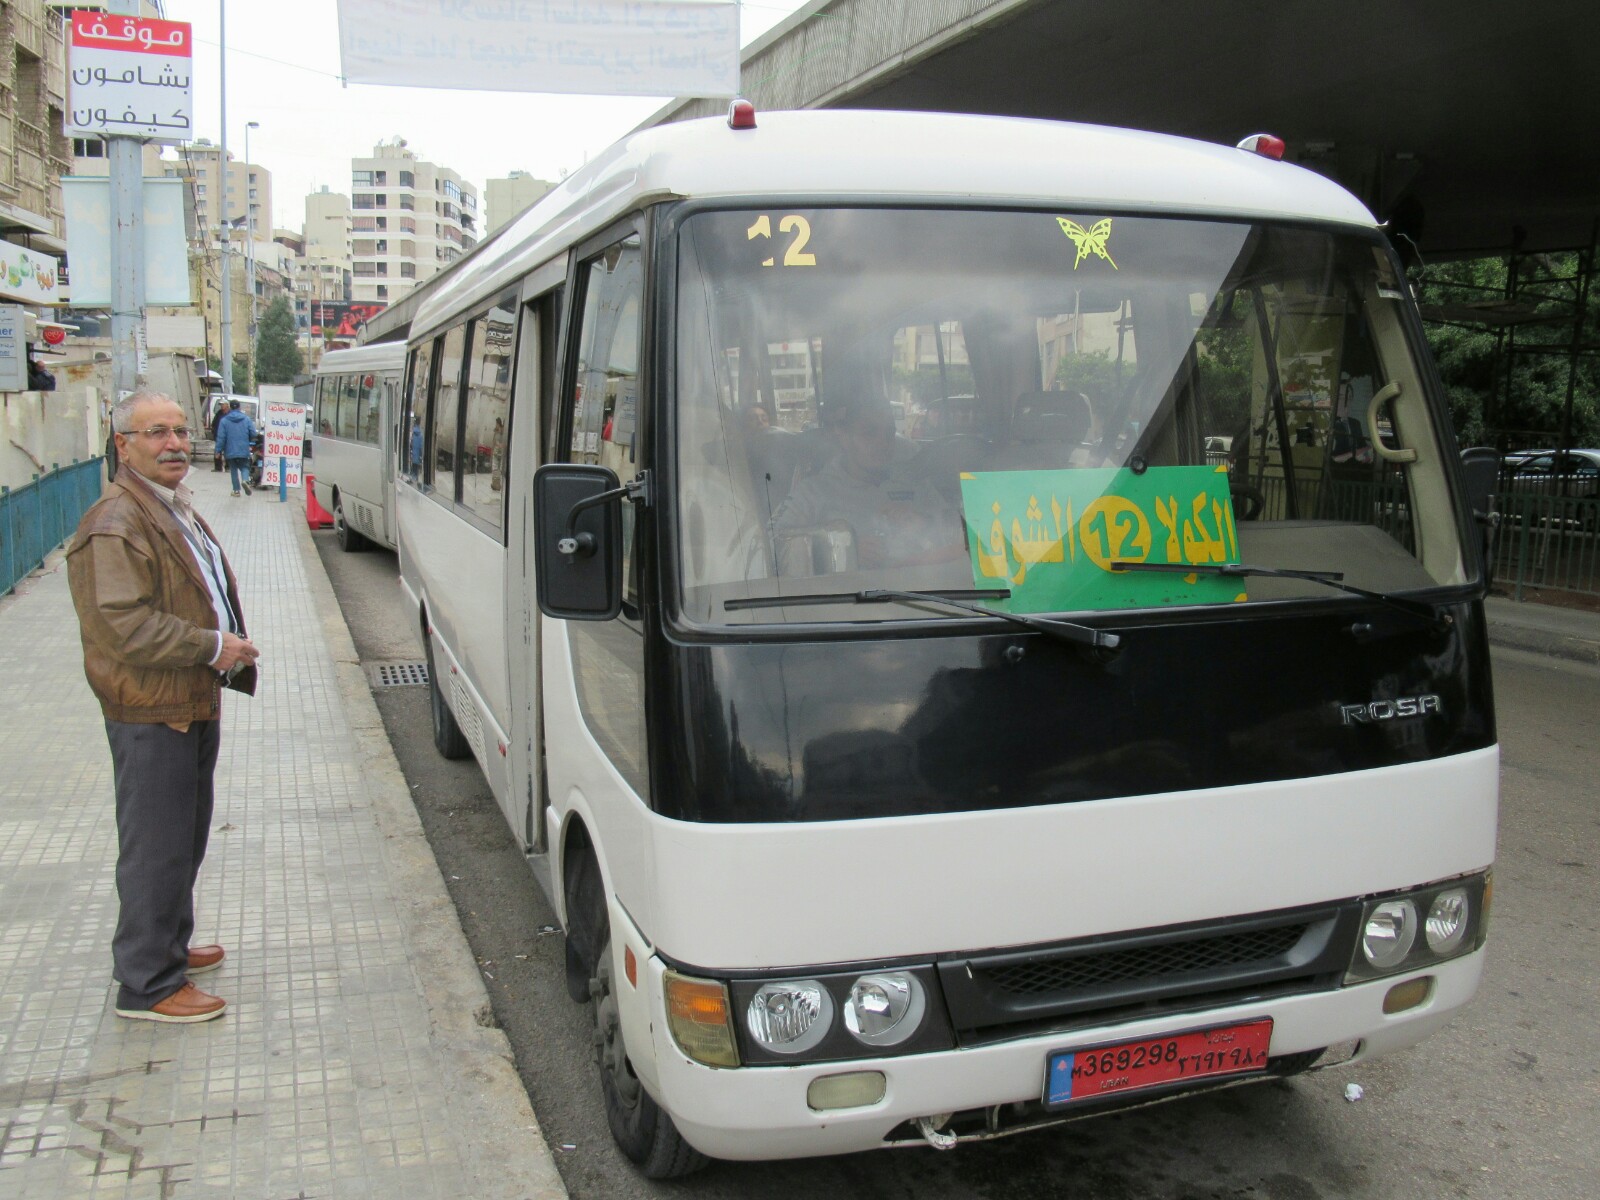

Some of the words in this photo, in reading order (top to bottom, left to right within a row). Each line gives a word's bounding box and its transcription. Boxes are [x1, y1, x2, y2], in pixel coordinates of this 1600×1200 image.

[78, 16, 184, 50] موقف
[72, 63, 190, 95] بشامون
[73, 105, 190, 132] كيفون
[268, 443, 300, 456] 30.000
[977, 493, 1075, 586] الشوف
[1088, 510, 1144, 558] 12
[1155, 491, 1236, 584] الكولا
[1340, 694, 1441, 725] ROSA
[1083, 1041, 1179, 1077] 369298
[1099, 1076, 1130, 1090] LIBAN
